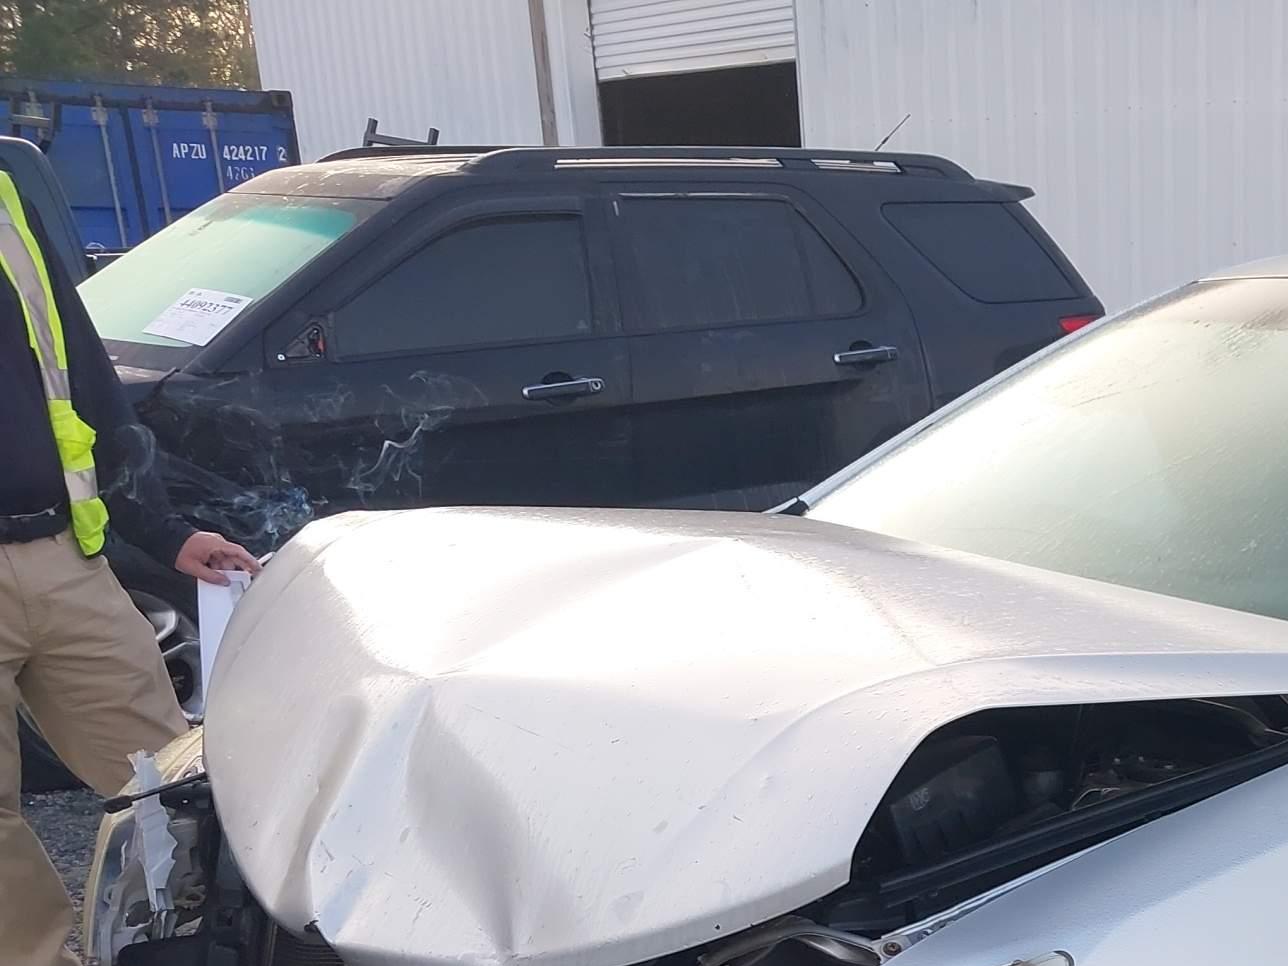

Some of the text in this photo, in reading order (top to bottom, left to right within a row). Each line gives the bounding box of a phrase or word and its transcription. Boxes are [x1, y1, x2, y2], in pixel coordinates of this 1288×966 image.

[173, 143, 288, 161] APZU 424217 2
